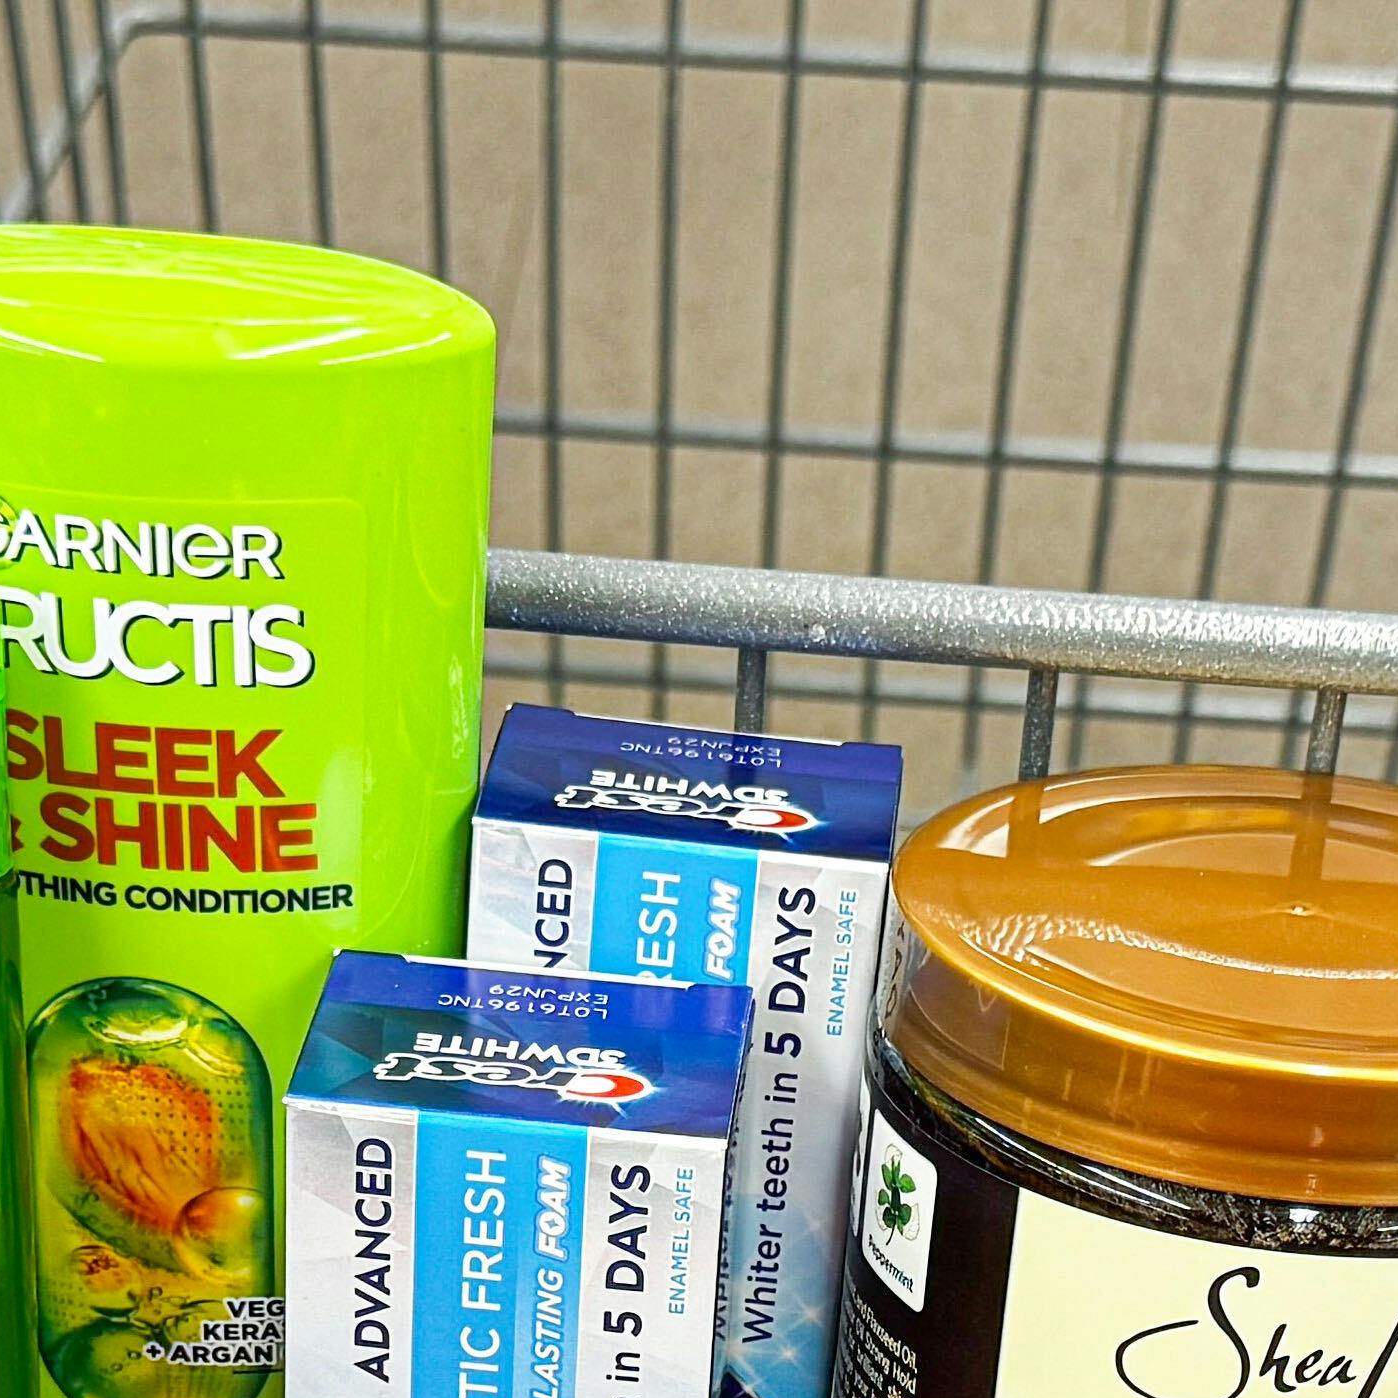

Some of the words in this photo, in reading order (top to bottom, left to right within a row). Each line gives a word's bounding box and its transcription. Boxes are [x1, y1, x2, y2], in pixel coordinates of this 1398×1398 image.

[0, 583, 316, 689] RUCTIS
[6, 706, 286, 799] SLEEK
[590, 770, 789, 805] 3DWHITE
[41, 795, 318, 873] SHINE
[20, 873, 117, 908] THING
[125, 882, 354, 914] CONDITIONER
[705, 878, 742, 979] FOAM
[837, 889, 858, 946] SAFE
[767, 886, 817, 1014] DAYS
[438, 994, 608, 1020] LOT6196TNC
[826, 950, 851, 1037] ENAMEL
[413, 1032, 626, 1070] 3DWHITE
[765, 1030, 802, 1058] 5
[765, 1072, 797, 1105] in
[533, 1156, 573, 1260] FOAM
[673, 1168, 695, 1221] SAFE
[759, 1119, 795, 1215] teeth
[354, 1137, 395, 1383] ADVANCED
[461, 1149, 508, 1312] FRESH
[604, 1163, 652, 1292] DAYS
[668, 1222, 691, 1315] ENAMEL
[603, 1310, 644, 1338] 5
[742, 1227, 783, 1344] Whiter
[146, 1345, 162, 1360] +
[170, 1345, 275, 1363] ARGAN
[605, 1353, 641, 1385] in
